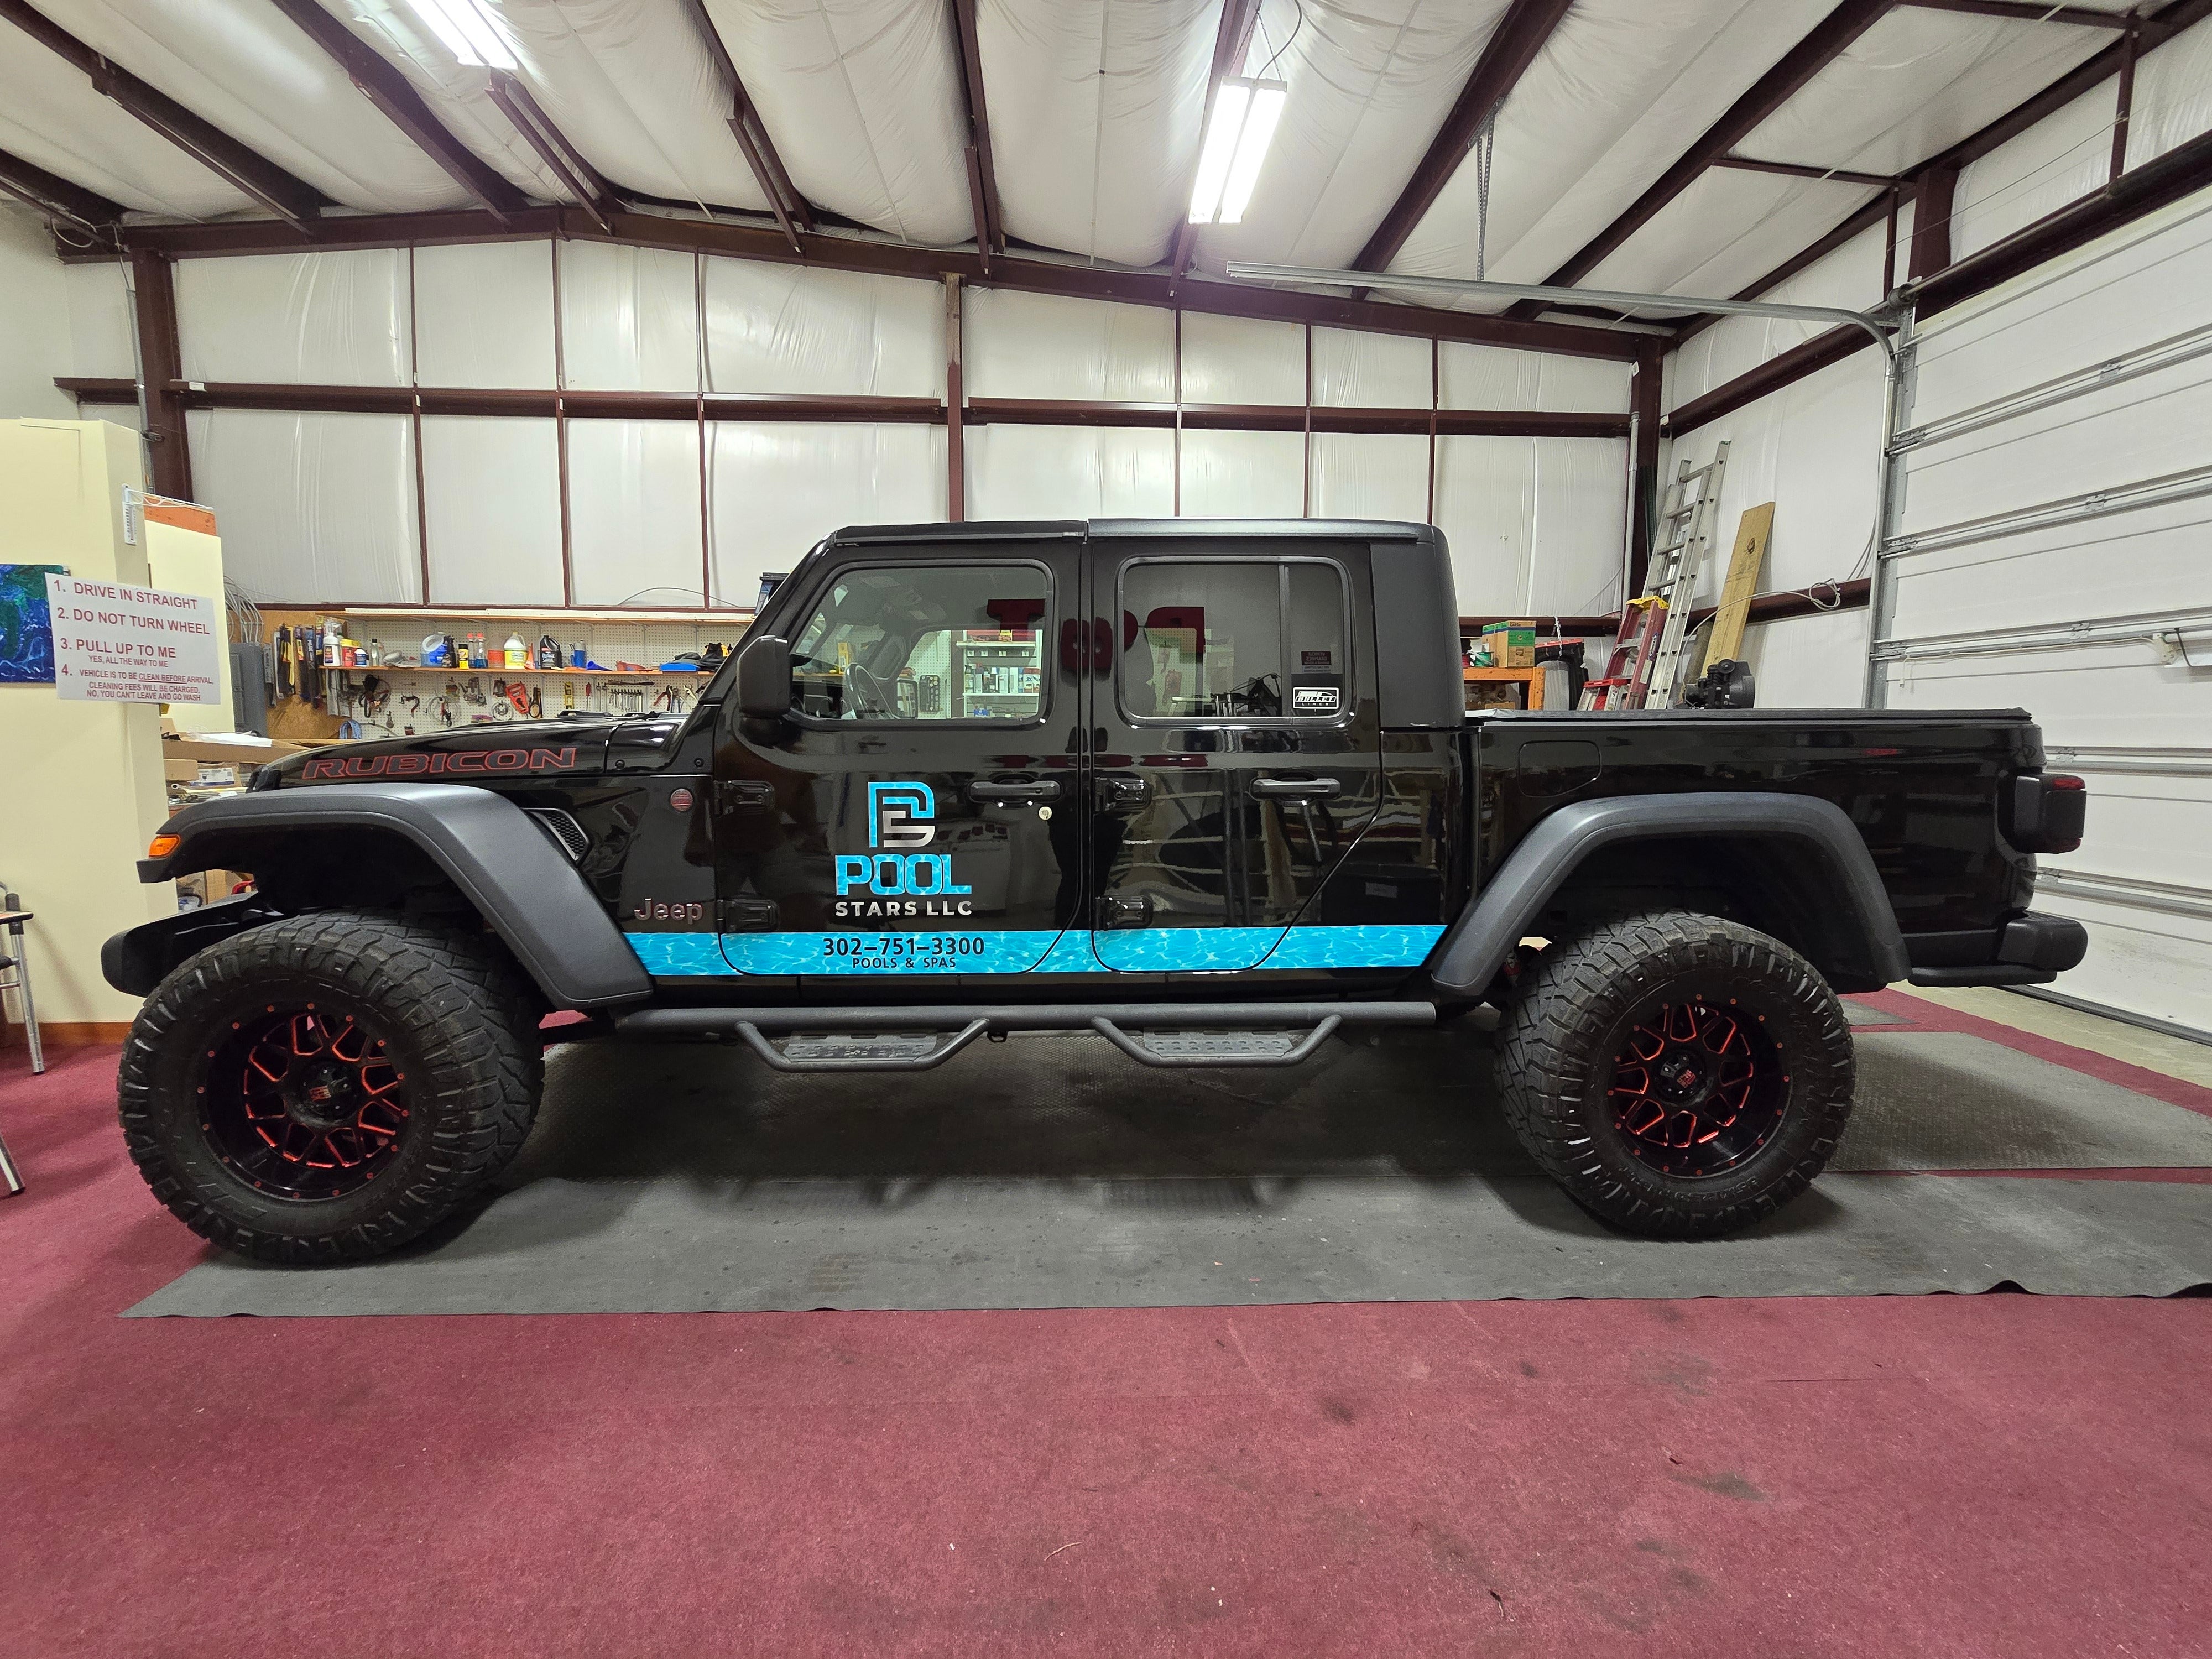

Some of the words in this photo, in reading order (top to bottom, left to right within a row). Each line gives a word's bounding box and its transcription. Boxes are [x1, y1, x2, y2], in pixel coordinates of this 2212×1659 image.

[54, 580, 66, 592] 1.
[74, 582, 116, 599] DRIVE
[119, 588, 133, 601] IN
[136, 591, 197, 609] STRAIGHT
[57, 607, 69, 619] 2.
[73, 608, 93, 622] DO
[98, 612, 126, 625] NOT
[129, 615, 164, 629] TURN
[167, 619, 210, 634] WHEEL
[60, 638, 72, 650] 3.
[76, 639, 112, 653] PULL
[116, 643, 133, 654] UP
[137, 644, 154, 656] TO
[158, 646, 176, 658] ME
[88, 655, 105, 664] YES,
[61, 664, 73, 676] 4.
[79, 669, 109, 678] VEHICLE
[161, 674, 186, 682] BEFORE
[89, 681, 123, 690] CLEANING
[302, 747, 577, 780] RUBICON
[835, 854, 972, 896] POOL
[634, 898, 703, 925] Jeep
[835, 901, 917, 916] STARS
[927, 901, 972, 916] LLC
[823, 937, 985, 956] 302-751-3300
[853, 957, 898, 969] POOLS
[905, 957, 915, 968] &
[924, 957, 956, 968] SPAS
